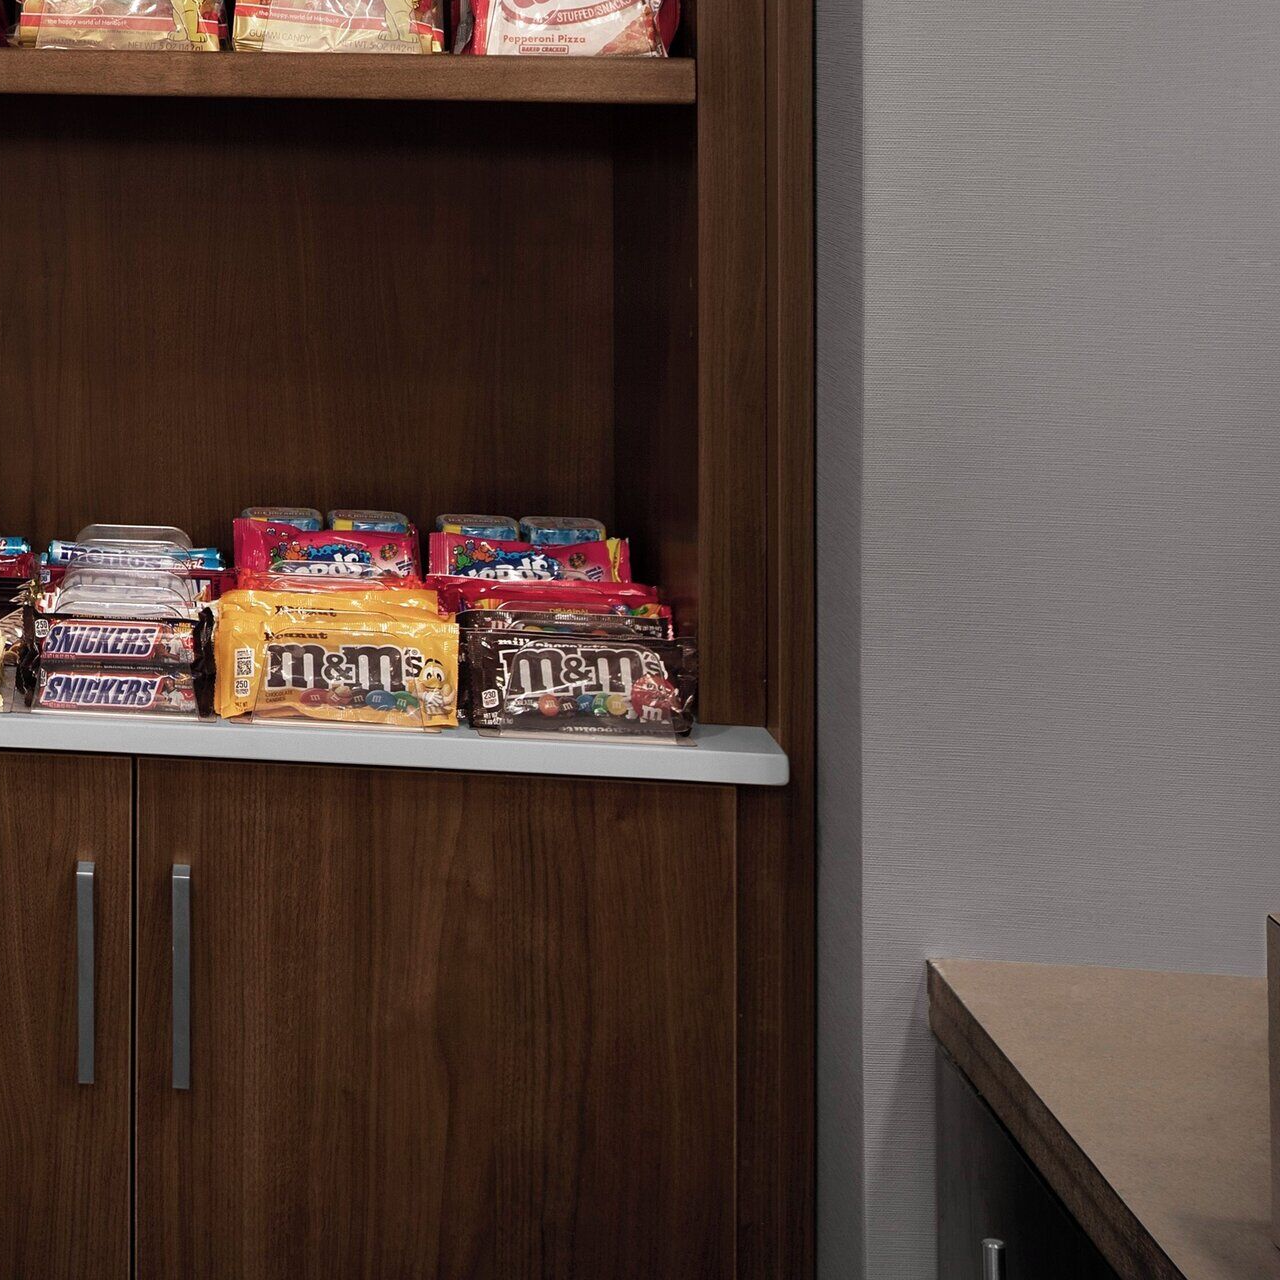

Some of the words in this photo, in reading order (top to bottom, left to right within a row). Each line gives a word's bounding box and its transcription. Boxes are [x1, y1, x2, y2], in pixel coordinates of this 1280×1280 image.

[557, 8, 594, 23] STUFFED
[282, 32, 311, 42] CANDY
[504, 34, 555, 44] Pepperoni
[558, 35, 586, 43] Pizza
[46, 626, 156, 654] SNICKERS
[264, 632, 328, 641] Peanut
[265, 643, 426, 691] m&m's
[499, 649, 668, 698] m&m's
[43, 676, 157, 705] SNICKERS
[236, 680, 248, 688] 250
